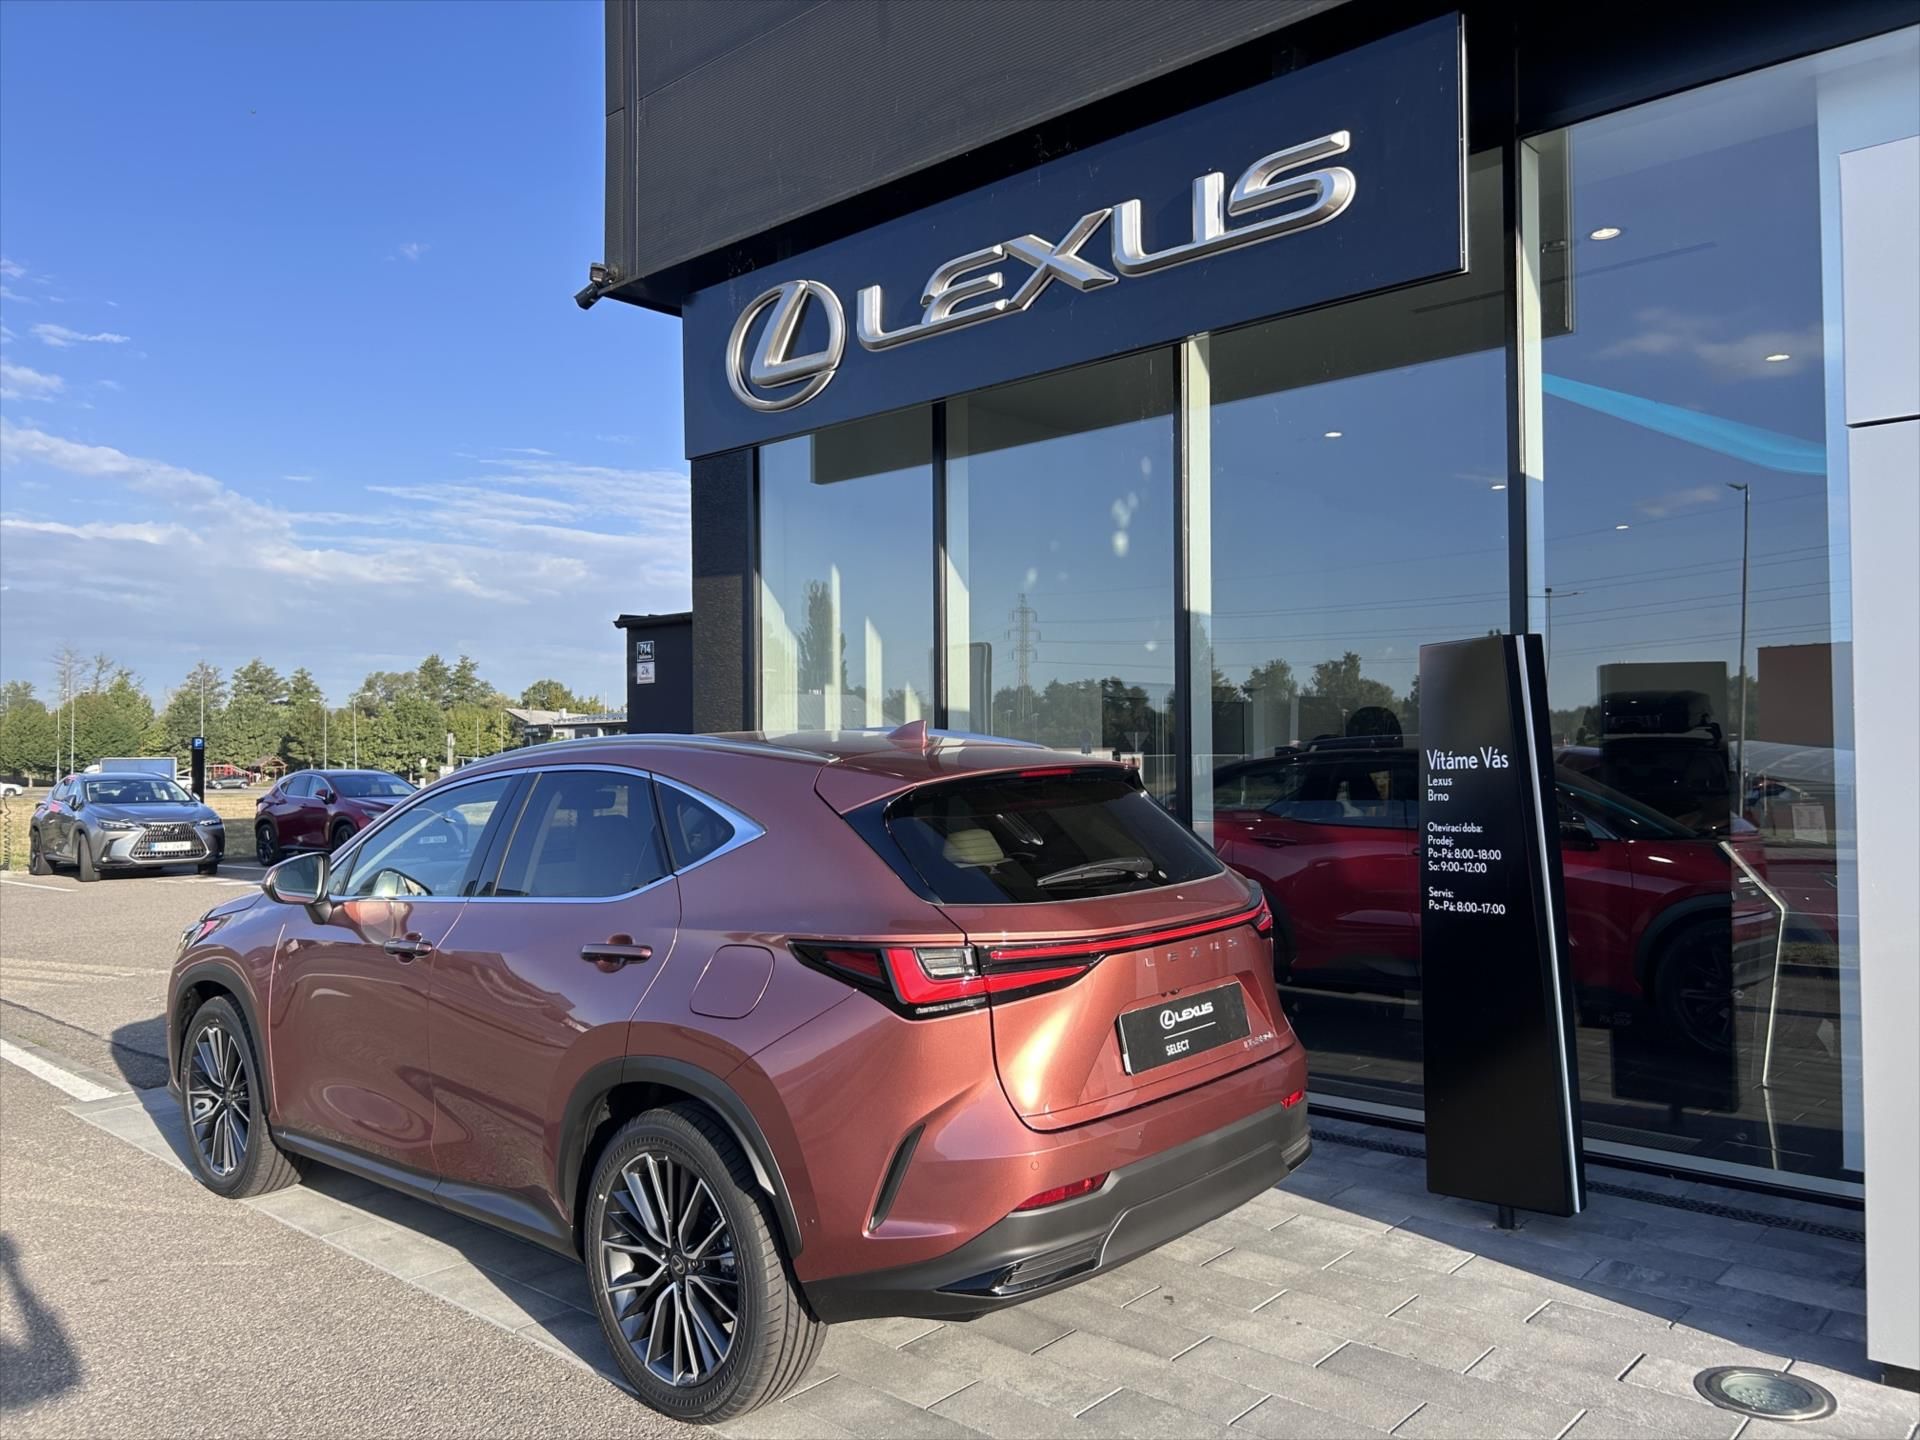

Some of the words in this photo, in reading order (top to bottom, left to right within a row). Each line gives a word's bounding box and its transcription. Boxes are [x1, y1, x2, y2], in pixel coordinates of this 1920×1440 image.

[856, 130, 1357, 352] LEXUS
[1426, 749, 1478, 770] Vítáme
[1479, 746, 1509, 769] Vás
[1427, 773, 1453, 787] Lexus
[1427, 788, 1450, 802] Brno
[1427, 821, 1462, 833] Otevírací
[1462, 822, 1484, 833] doba:
[1427, 834, 1455, 848] Prodej:
[1428, 847, 1454, 859] Po-Pá:
[1454, 848, 1502, 861] 8:00-18:00
[1428, 860, 1440, 872] So:
[1440, 861, 1487, 874] 9:00-12:00
[1428, 886, 1454, 899] Servis:
[1428, 899, 1456, 912] Po-Pá:
[1456, 901, 1506, 915] 8:00-17:00
[1174, 1001, 1214, 1022] LEXUS
[1165, 1039, 1190, 1056] SELECT
